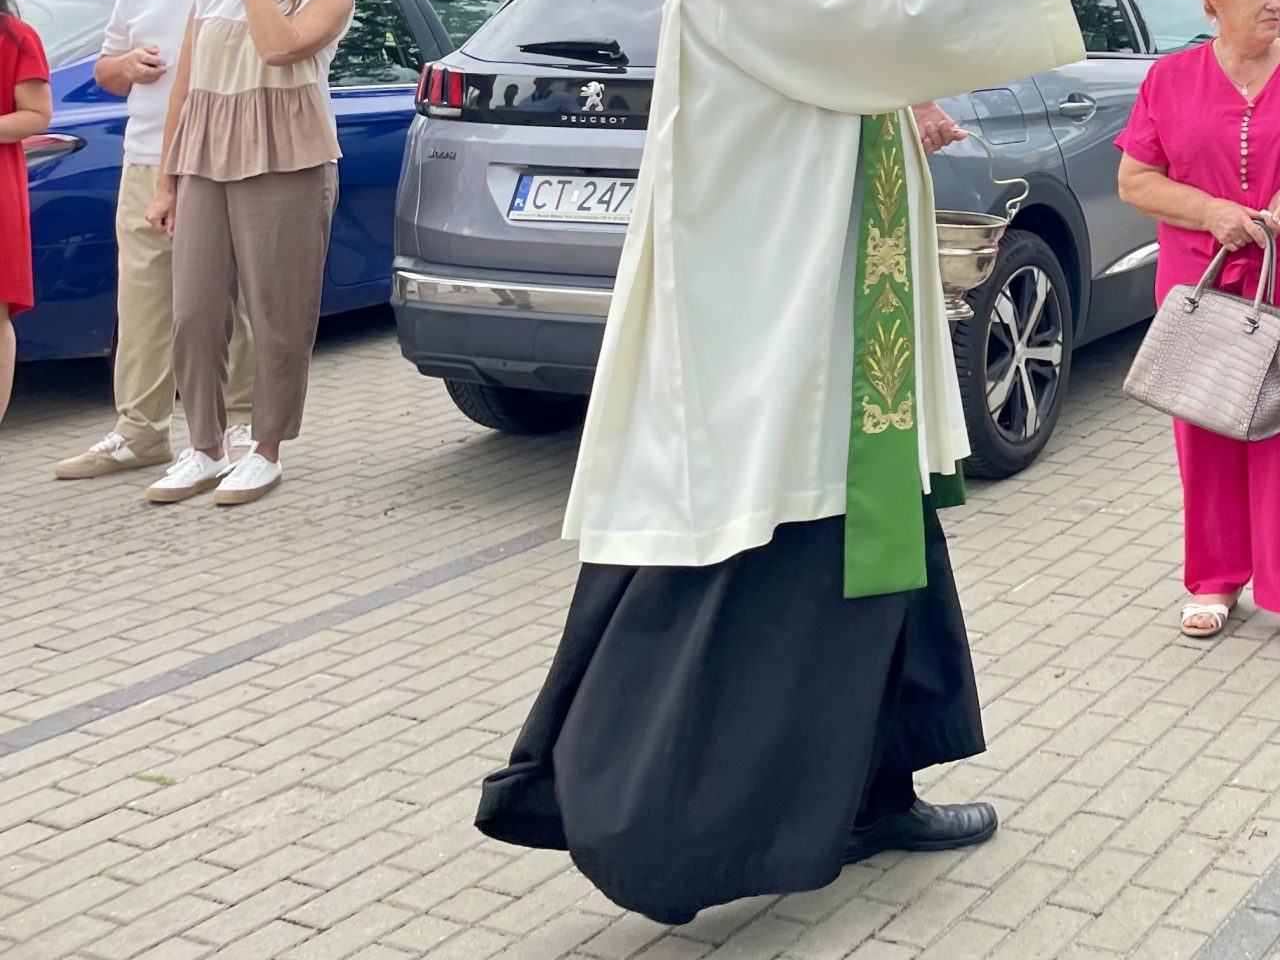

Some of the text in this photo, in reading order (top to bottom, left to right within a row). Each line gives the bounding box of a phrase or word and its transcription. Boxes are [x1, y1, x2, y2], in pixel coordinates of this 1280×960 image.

[561, 115, 627, 124] PEUGEOT
[532, 179, 635, 212] CT 247
[514, 198, 524, 207] PL
